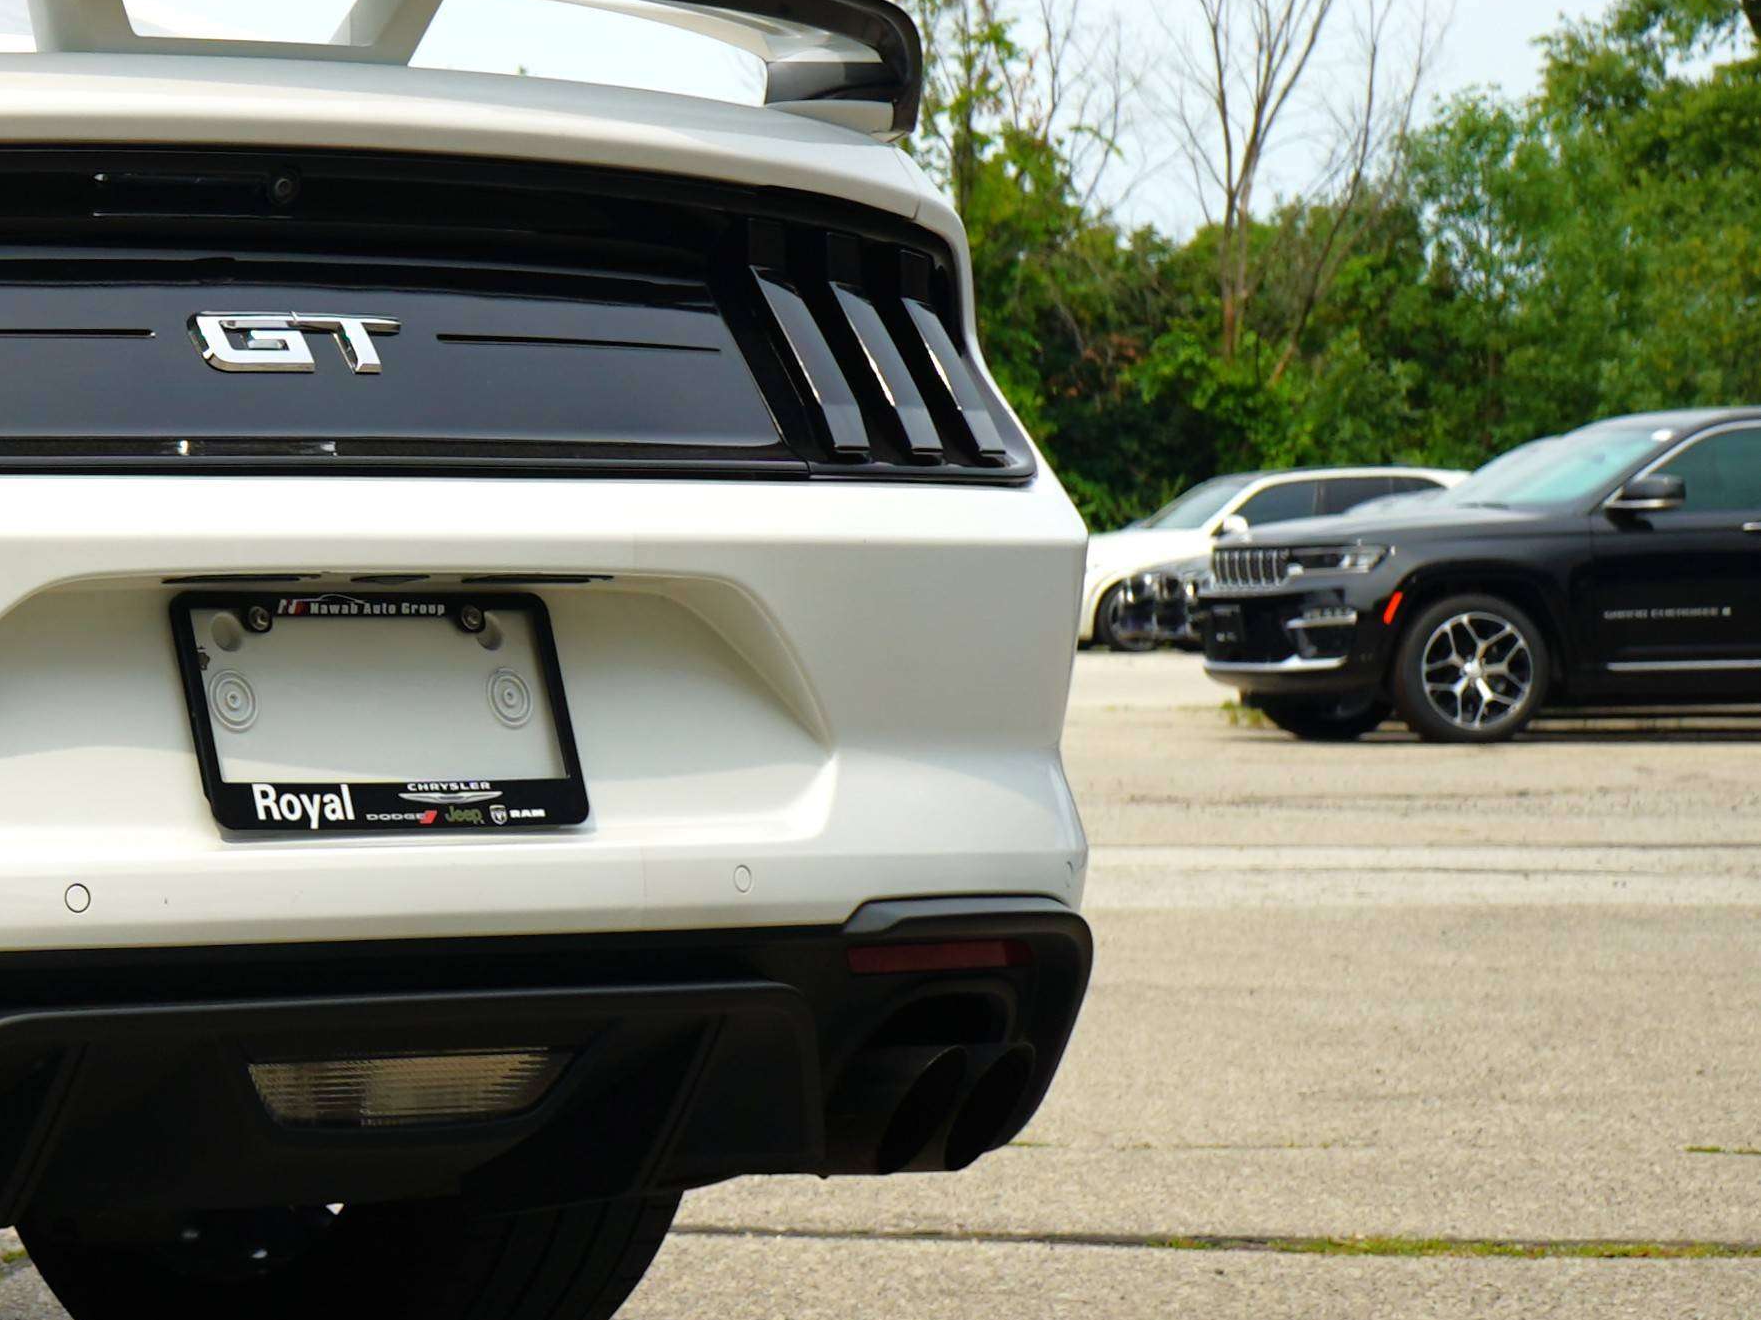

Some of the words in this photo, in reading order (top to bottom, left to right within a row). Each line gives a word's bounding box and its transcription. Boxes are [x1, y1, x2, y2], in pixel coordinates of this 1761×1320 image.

[186, 310, 402, 375] GT
[309, 602, 358, 615] Nawab
[363, 603, 397, 615] Auto
[401, 603, 446, 617] Group
[406, 780, 492, 792] CHRYSLER
[250, 782, 356, 830] Royal
[365, 812, 428, 822] DODGE
[444, 805, 483, 824] Jeep
[509, 808, 547, 819] RAM
